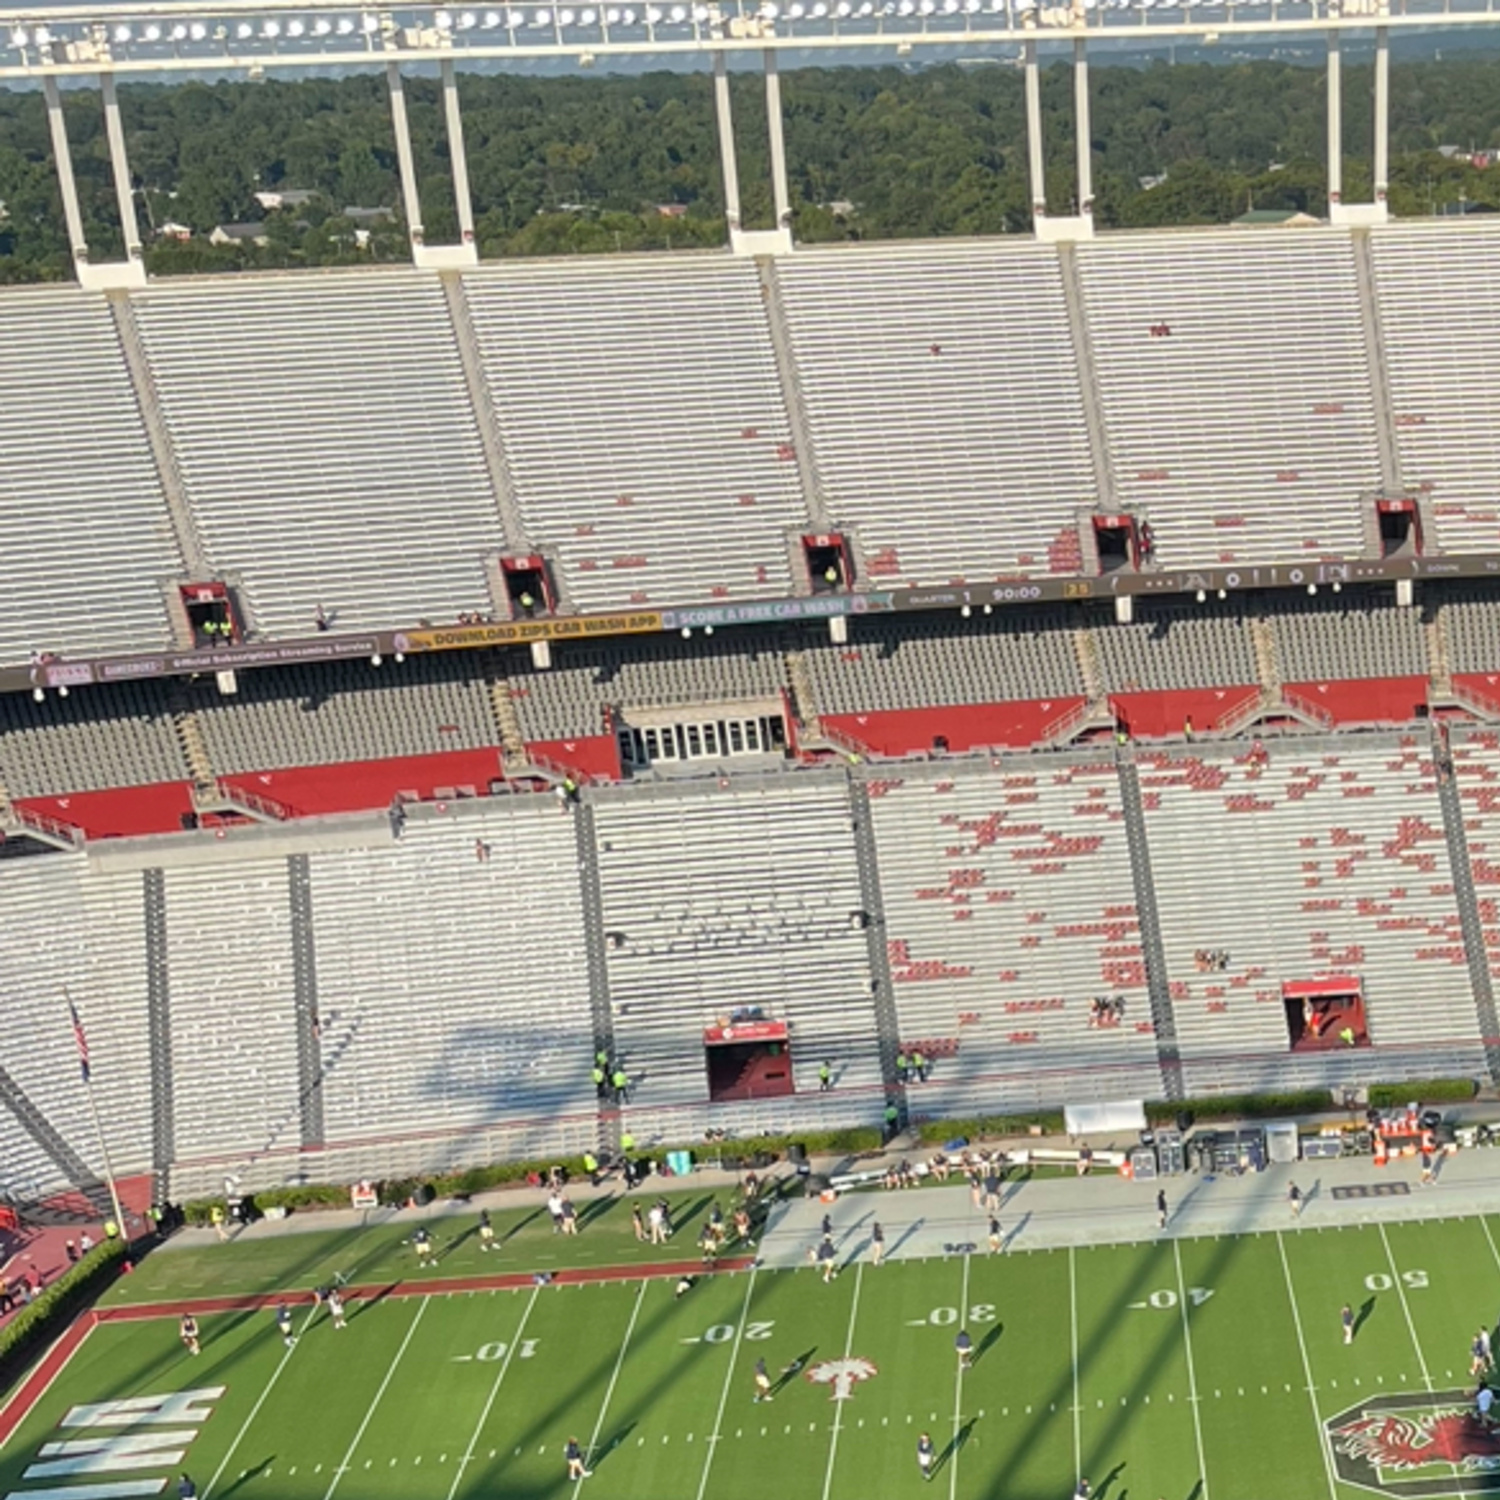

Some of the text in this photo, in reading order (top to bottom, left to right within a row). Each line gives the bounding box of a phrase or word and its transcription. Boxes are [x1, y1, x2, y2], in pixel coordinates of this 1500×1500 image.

[993, 586, 1041, 600] 90:00
[679, 600, 845, 626] SCORE A FREE CAR WASH
[433, 615, 657, 647] DOWNLOAD ZIPS CAR WASH APP
[1364, 1270, 1431, 1292] 50
